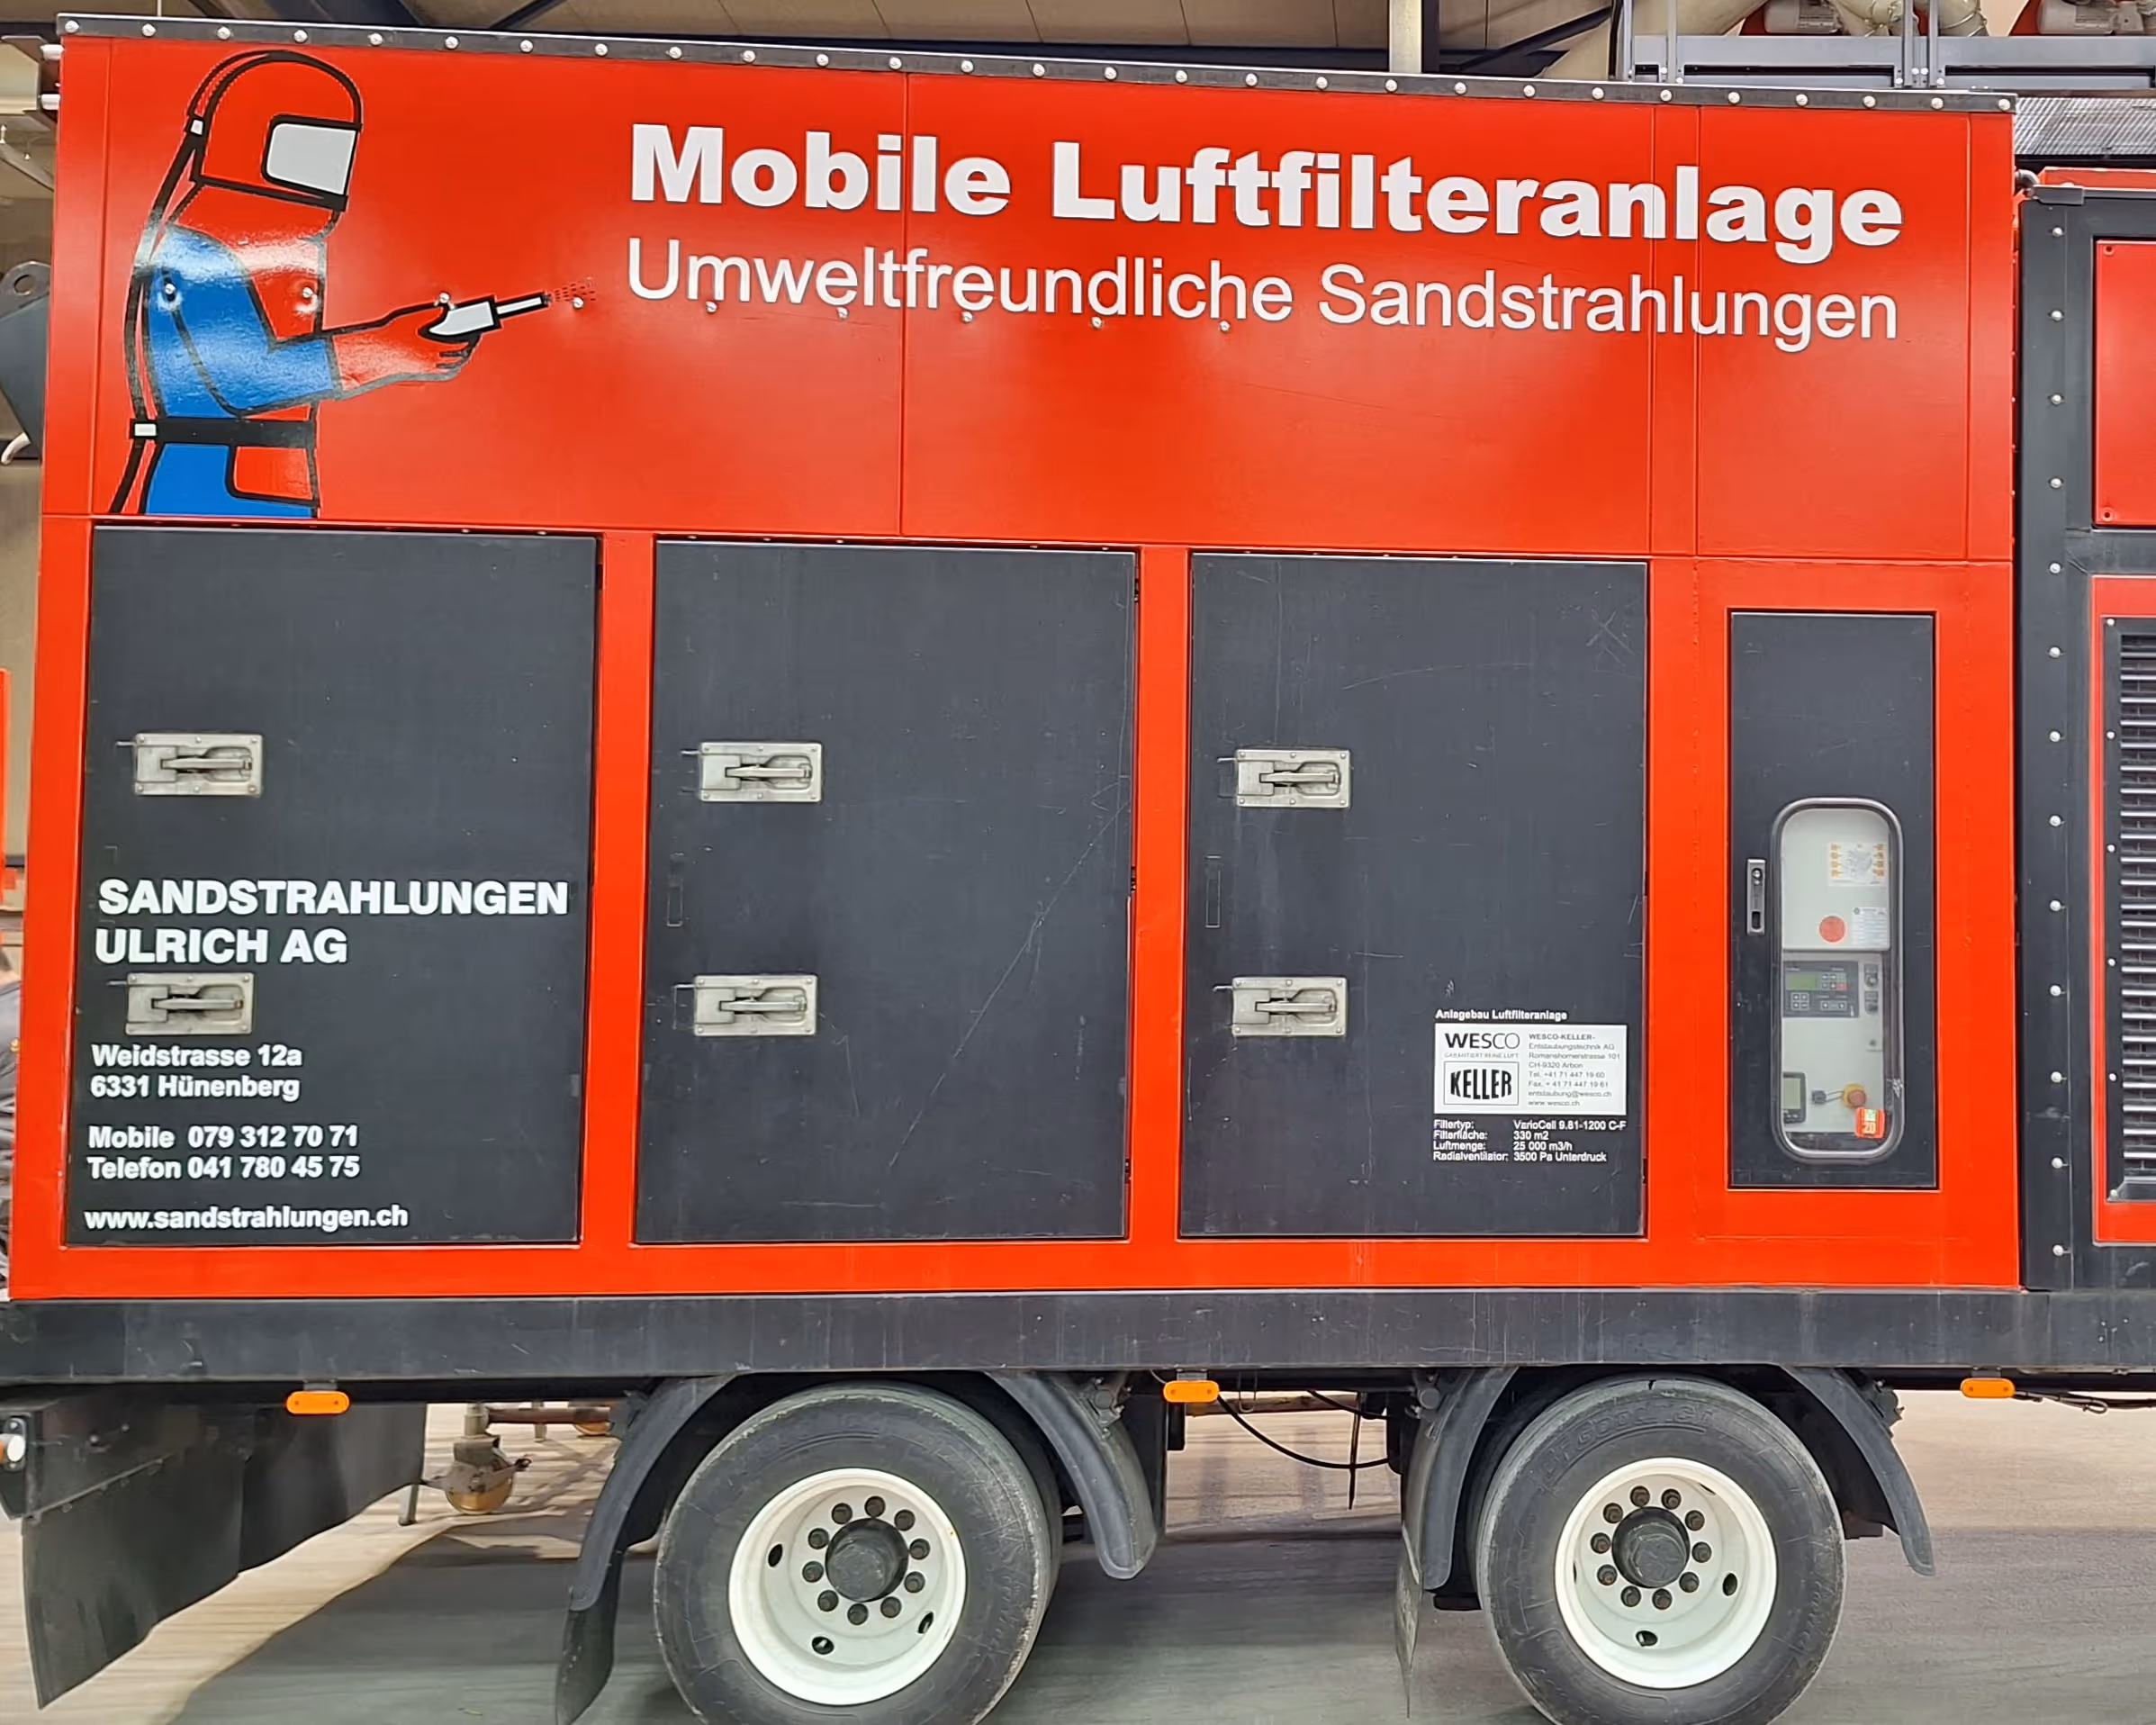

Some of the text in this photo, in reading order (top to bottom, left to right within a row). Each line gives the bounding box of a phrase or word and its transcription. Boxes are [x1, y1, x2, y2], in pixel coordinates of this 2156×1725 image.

[631, 123, 1903, 264] Mobile Luftfilteranlage
[628, 237, 1898, 353] Umweltfreundliche Sandstrahlungen
[98, 879, 569, 915] SANDSTRAHLUNGEN
[95, 928, 348, 964] ULRICH AG
[1435, 1009, 1568, 1022] Anlagebau Luftfilteranlage
[1444, 1033, 1520, 1050] WESCO
[91, 1044, 302, 1068] Weidstrasse 12a
[90, 1075, 301, 1102] 6331 Hünenberg
[1450, 1069, 1512, 1100] KELLER
[87, 1125, 359, 1150] Mobile 079 312 70 71
[1513, 1131, 1531, 1140] 330
[1534, 1131, 1549, 1140] m2
[1513, 1141, 1526, 1151] 25
[1528, 1141, 1547, 1151] 000
[1548, 1141, 1573, 1151] m3/h
[86, 1156, 361, 1180] Telefon 041 780 45 75
[1513, 1152, 1538, 1161] 3500
[1539, 1152, 1553, 1161] Pa
[1555, 1152, 1607, 1161] Unterdruck
[84, 1205, 410, 1233] www.sandstrahlungen.ch
